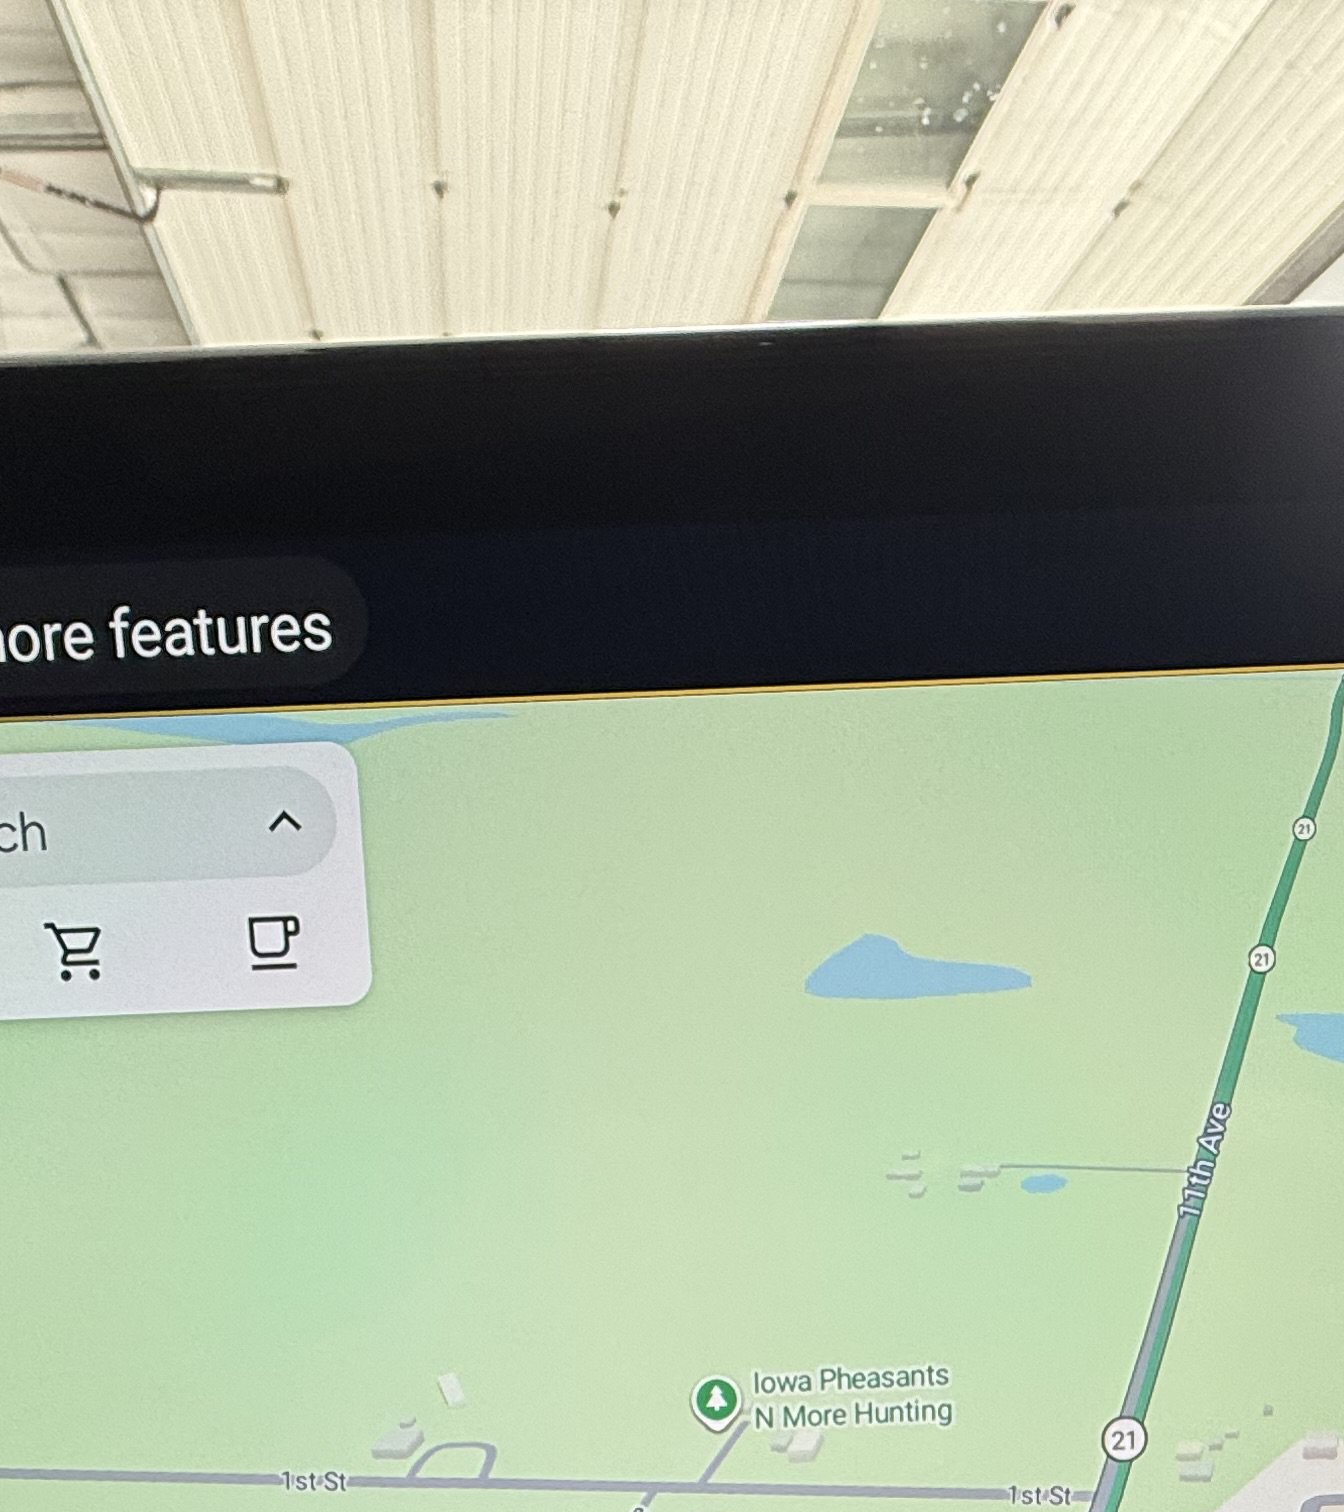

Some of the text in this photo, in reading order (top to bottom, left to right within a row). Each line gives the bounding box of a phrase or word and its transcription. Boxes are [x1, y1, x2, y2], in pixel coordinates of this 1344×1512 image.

[108, 605, 333, 659] features
[1297, 823, 1311, 835] 21
[1254, 952, 1269, 967] 21
[1179, 1103, 1231, 1217] 11th Ave
[754, 1365, 949, 1394] Iowa Pheasants
[755, 1399, 953, 1429] N More Hunting
[1111, 1430, 1136, 1450] 21
[282, 1471, 346, 1492] 1st St
[1008, 1485, 1072, 1506] 1st St
